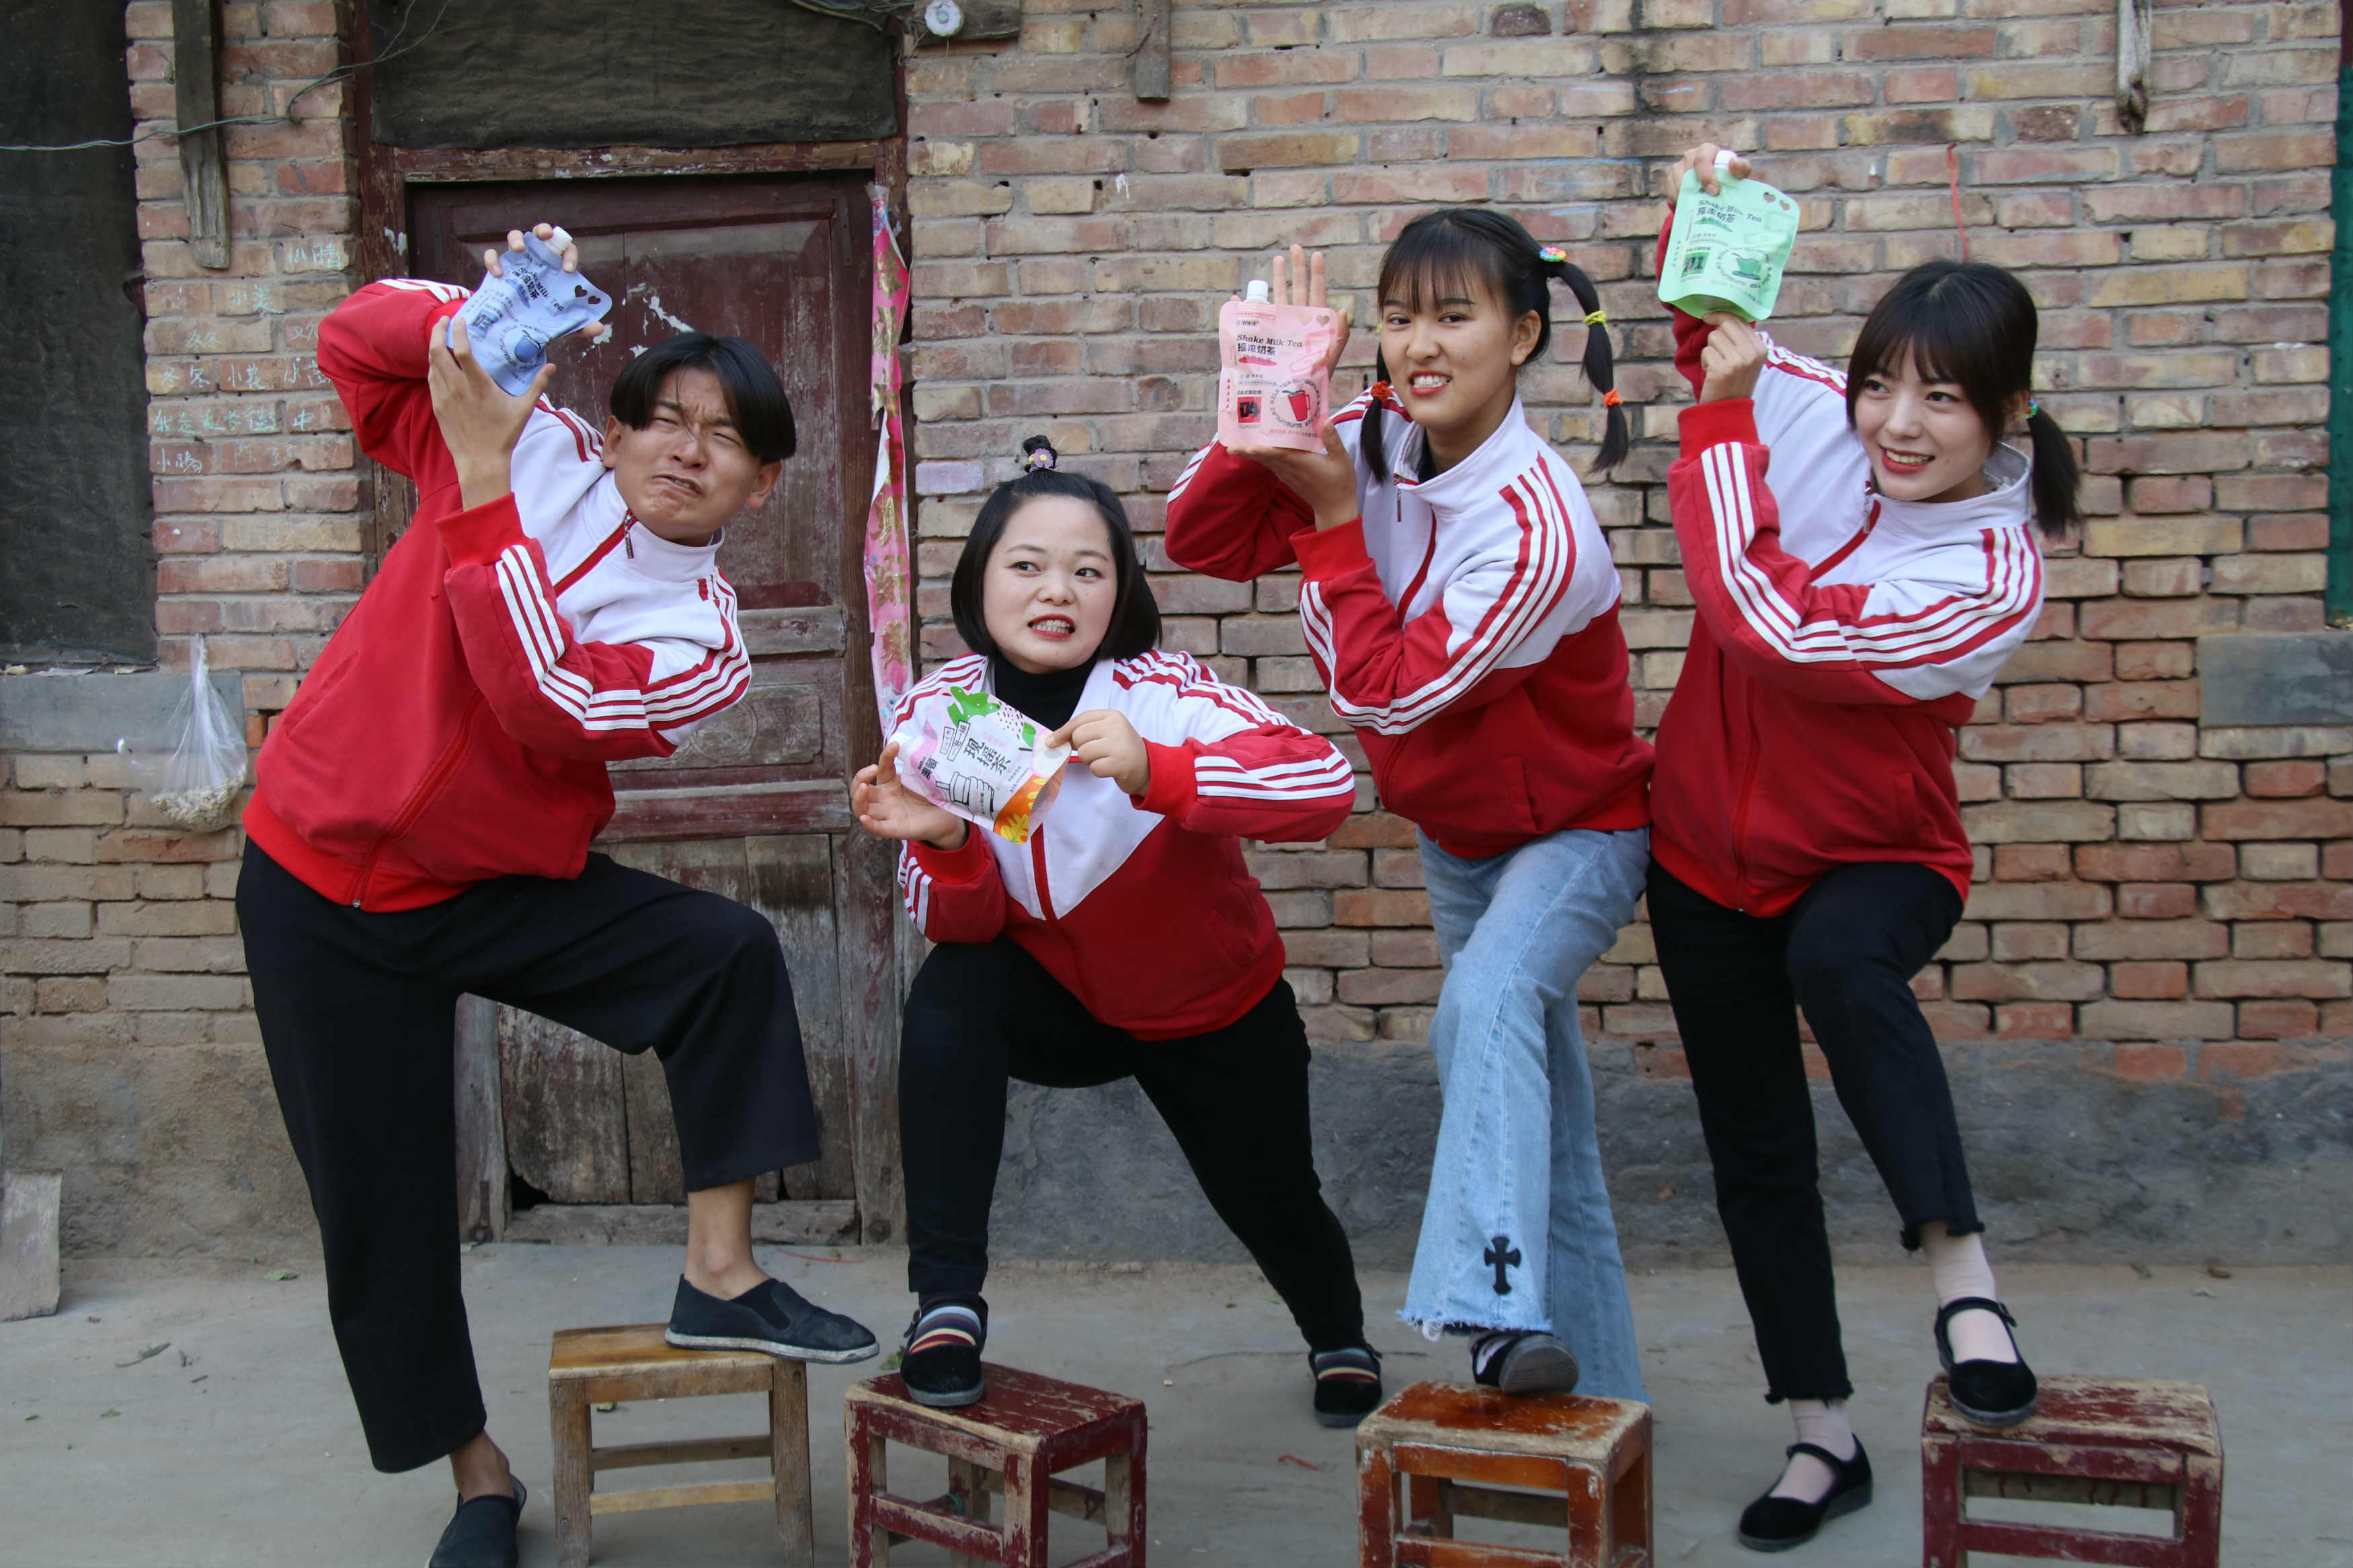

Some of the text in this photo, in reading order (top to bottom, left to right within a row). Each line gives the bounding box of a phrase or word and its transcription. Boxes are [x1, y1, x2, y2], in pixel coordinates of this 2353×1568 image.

[1236, 333, 1303, 347] Shake Milk Tea
[963, 738, 1011, 775] 现摇茶
